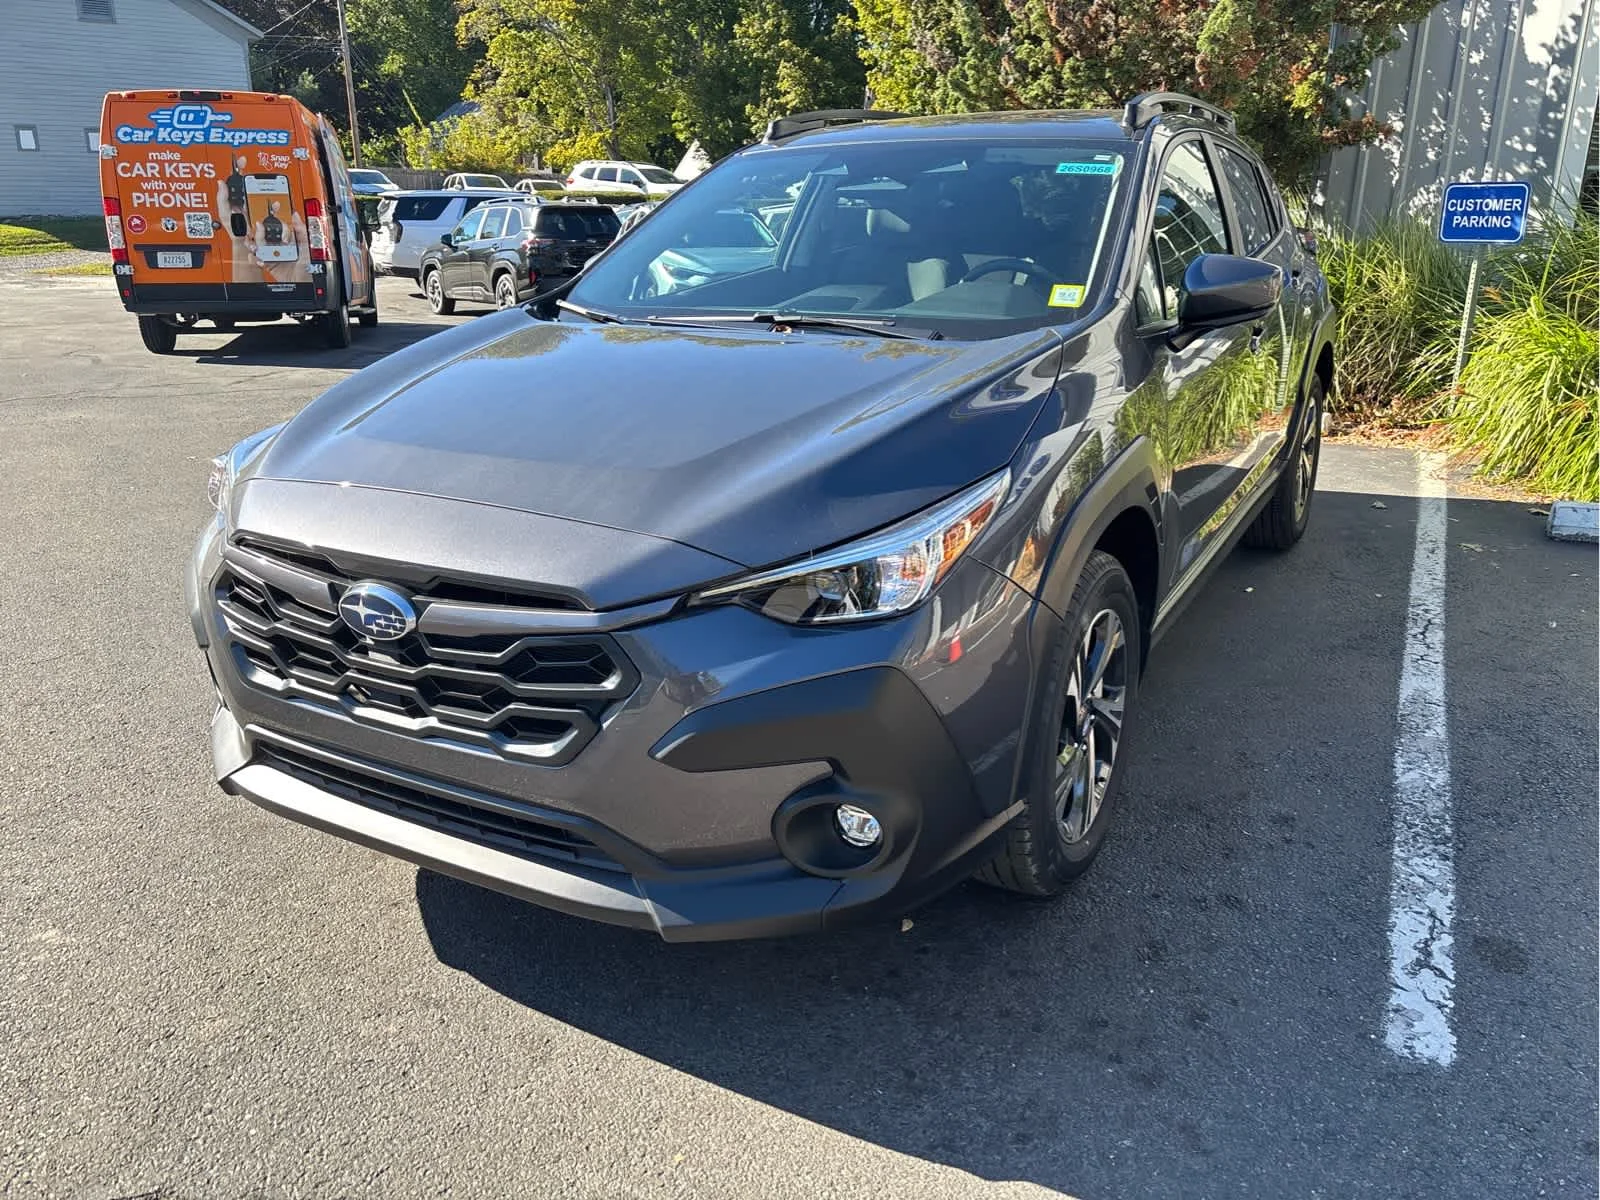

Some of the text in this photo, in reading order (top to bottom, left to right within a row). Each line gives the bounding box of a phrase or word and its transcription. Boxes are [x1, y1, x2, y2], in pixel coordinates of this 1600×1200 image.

[117, 126, 289, 146] Car Keys Express
[148, 151, 181, 161] make
[270, 154, 290, 162] Snap
[117, 162, 216, 178] CAR KEYS
[274, 161, 289, 170] Key
[1060, 165, 1112, 174] 26S0968
[141, 180, 196, 193] with your
[132, 192, 208, 208] PHONE!
[1447, 198, 1522, 212] CUSTOMER
[1452, 215, 1512, 228] PARKING
